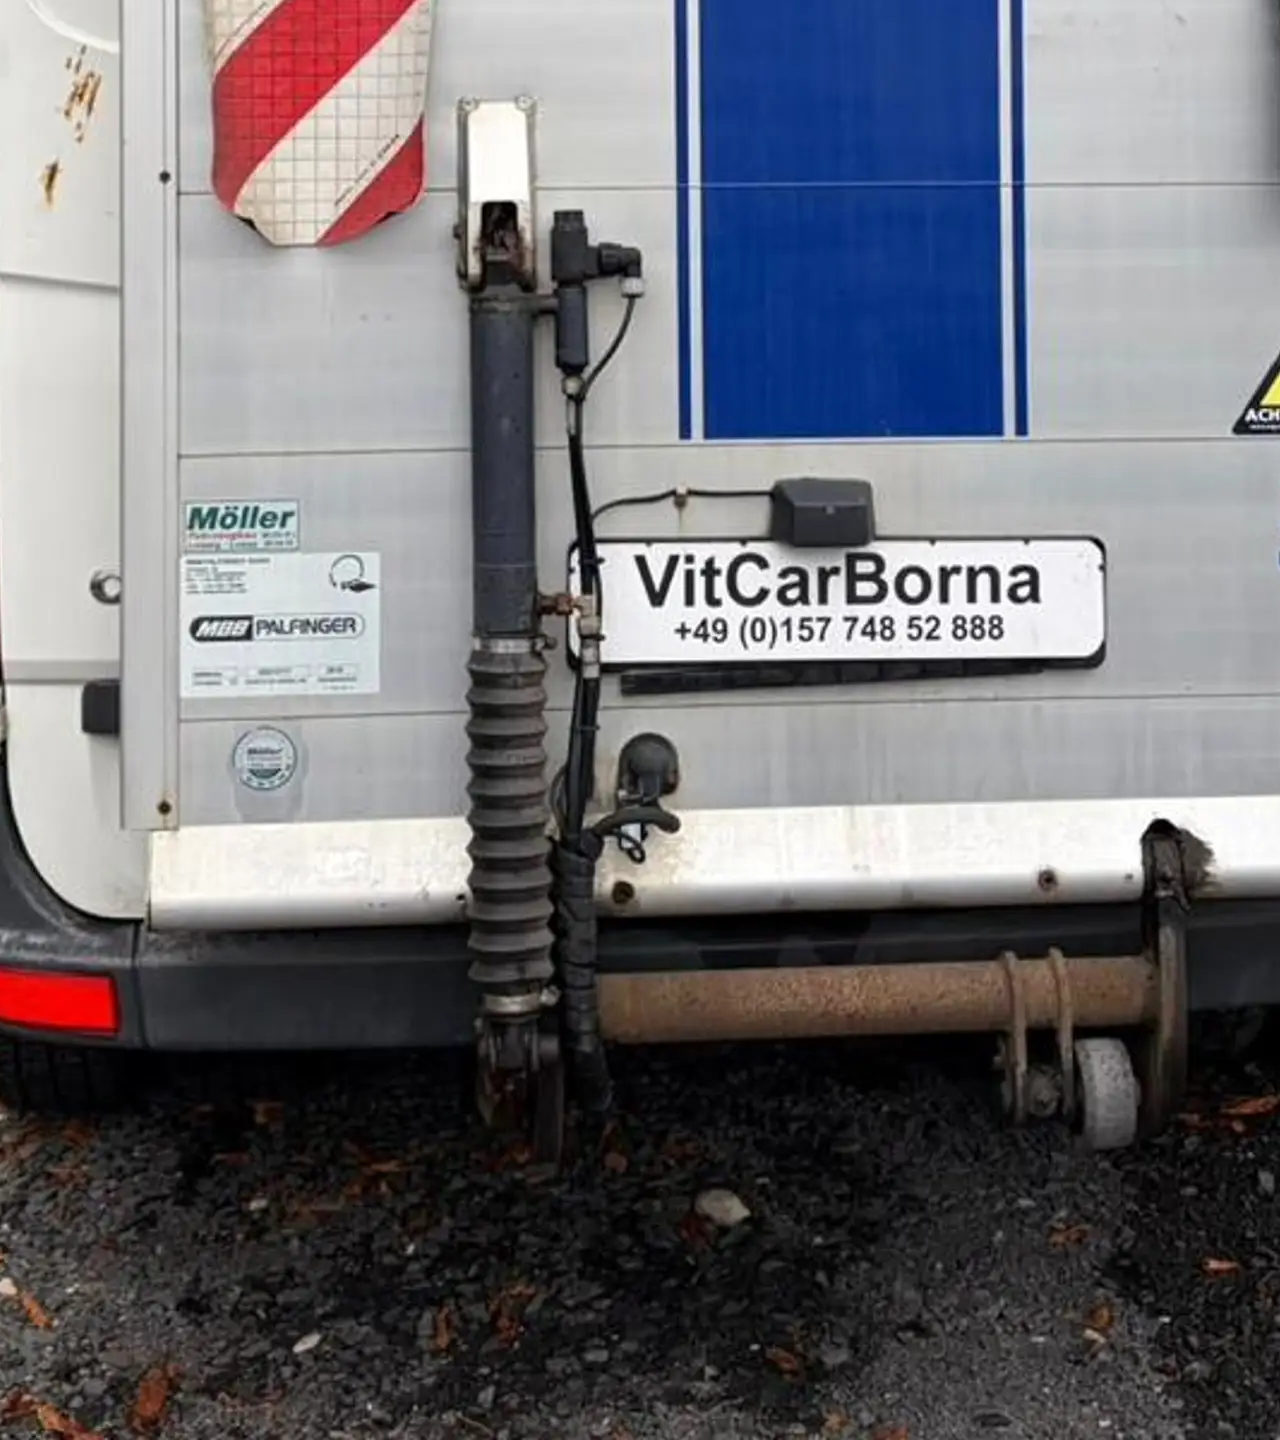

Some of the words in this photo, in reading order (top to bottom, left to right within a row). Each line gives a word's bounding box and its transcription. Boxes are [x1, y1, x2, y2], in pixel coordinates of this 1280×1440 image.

[187, 505, 296, 531] Möller
[634, 552, 1041, 607] VitCarBorna
[195, 619, 250, 638] MBB
[256, 616, 357, 636] PALFINGER
[674, 618, 729, 643] +49
[739, 616, 831, 649] (0)157
[843, 617, 896, 642] 748
[907, 616, 941, 641] 52
[952, 615, 1004, 641] 888
